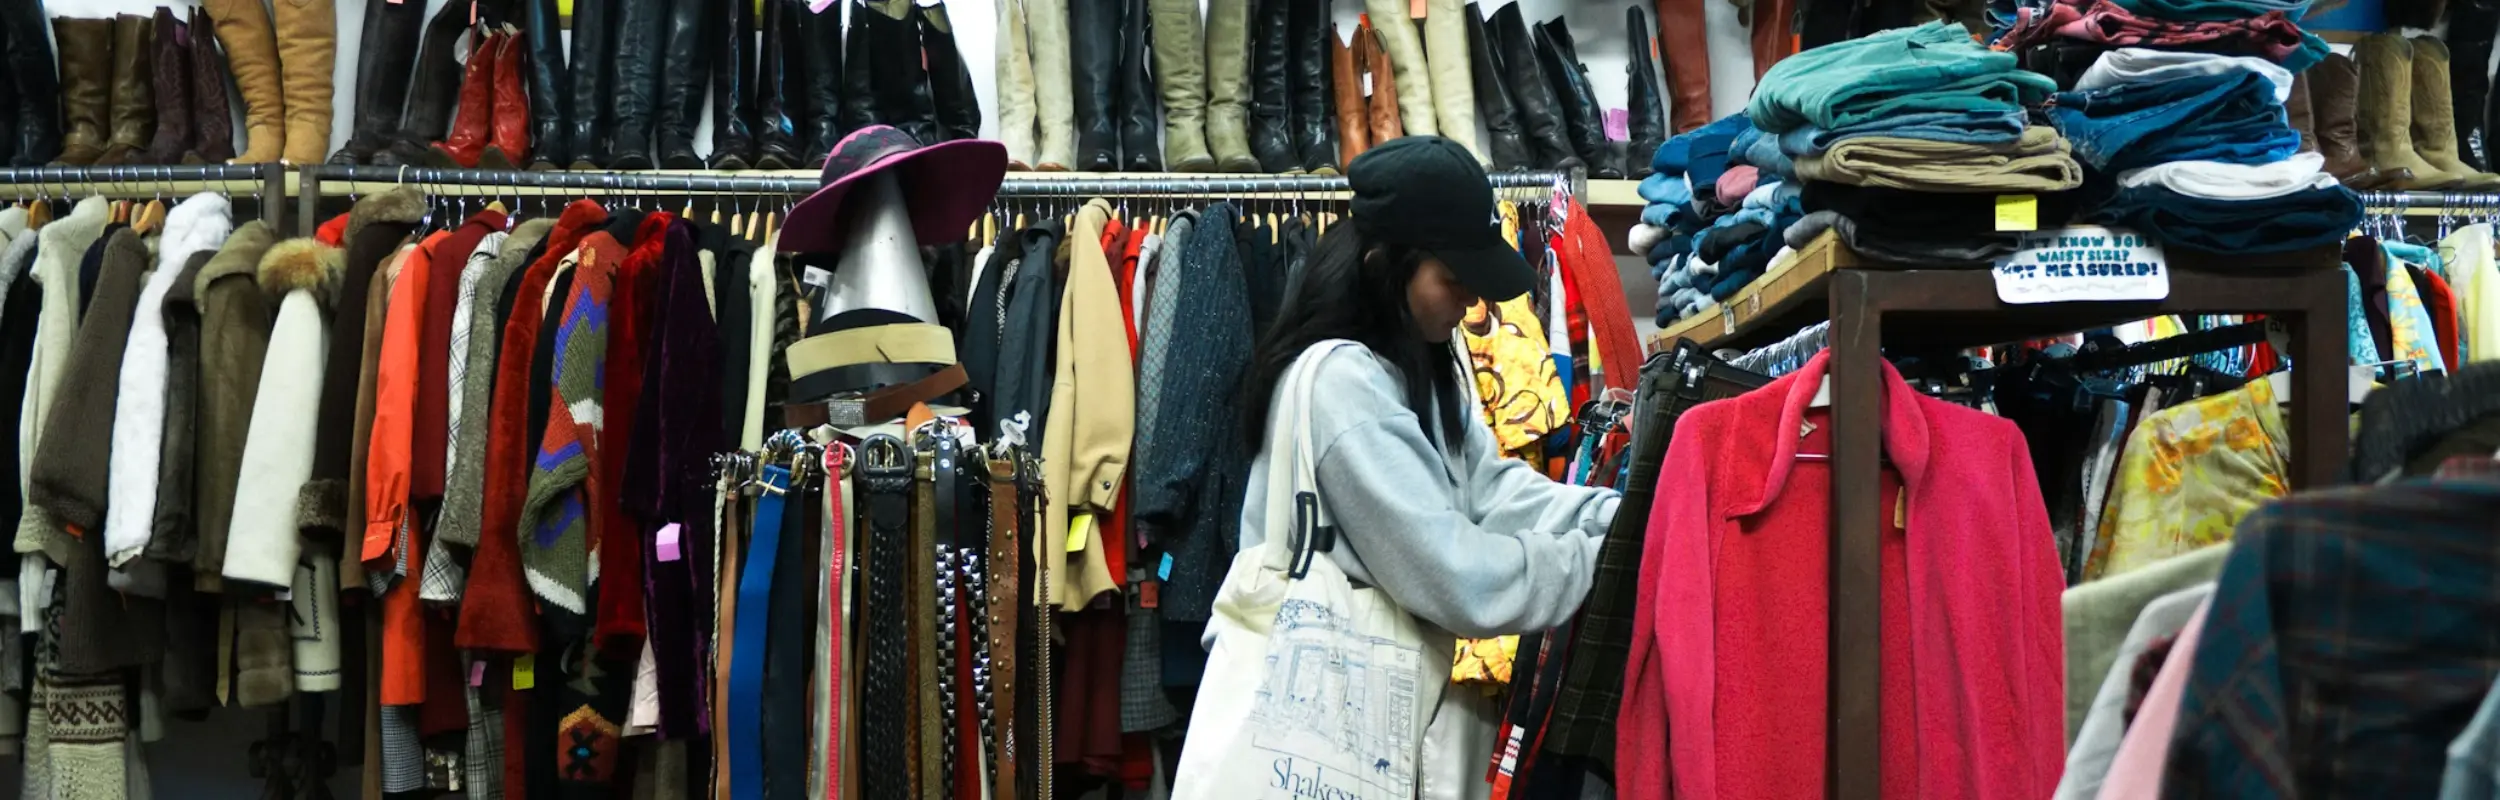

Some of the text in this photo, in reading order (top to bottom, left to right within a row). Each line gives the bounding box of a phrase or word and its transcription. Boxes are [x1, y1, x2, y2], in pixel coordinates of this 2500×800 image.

[2058, 236, 2105, 248] KNOW
[2113, 235, 2155, 248] YOU
[2036, 249, 2130, 262] WAIST SIZE?
[2045, 262, 2158, 277] MEASURED!
[1270, 757, 1362, 800] Shakes
